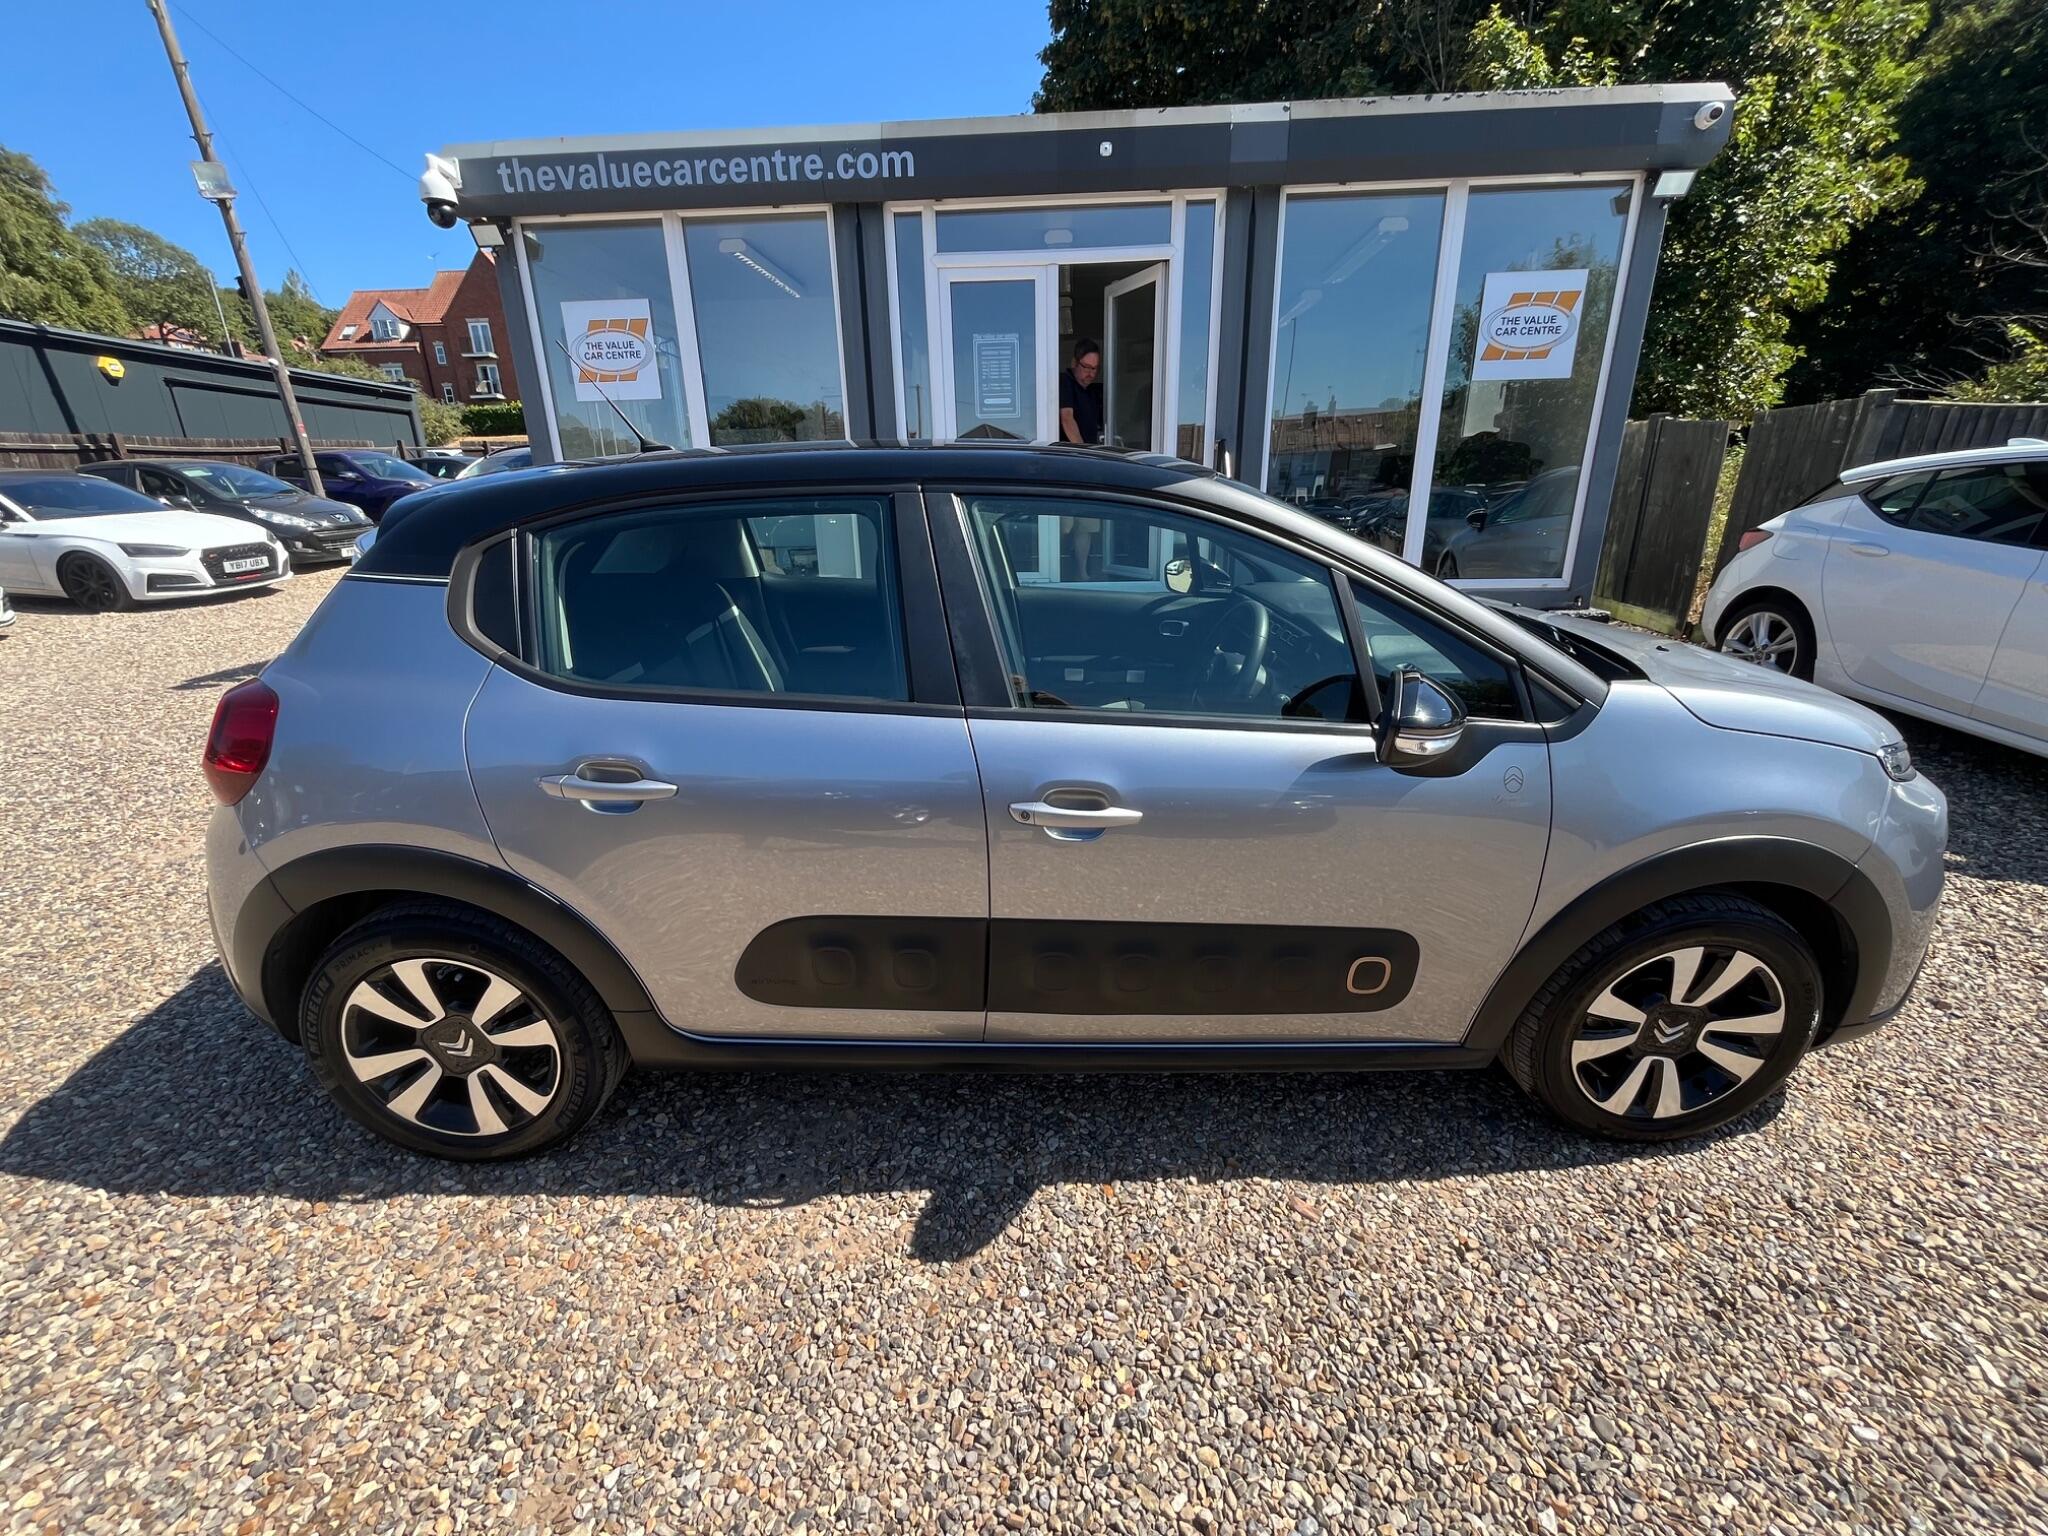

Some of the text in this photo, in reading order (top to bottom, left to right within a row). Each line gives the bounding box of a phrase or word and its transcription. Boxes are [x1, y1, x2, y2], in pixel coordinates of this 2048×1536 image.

[497, 149, 915, 194] thevaluecarcentre.com
[1501, 315, 1557, 326] THE VALUE
[1495, 325, 1562, 336] CAR CENTRE
[586, 341, 635, 350] THE VALUE
[584, 350, 641, 361] CAR CENTRE
[306, 973, 331, 1055] MICHELIN
